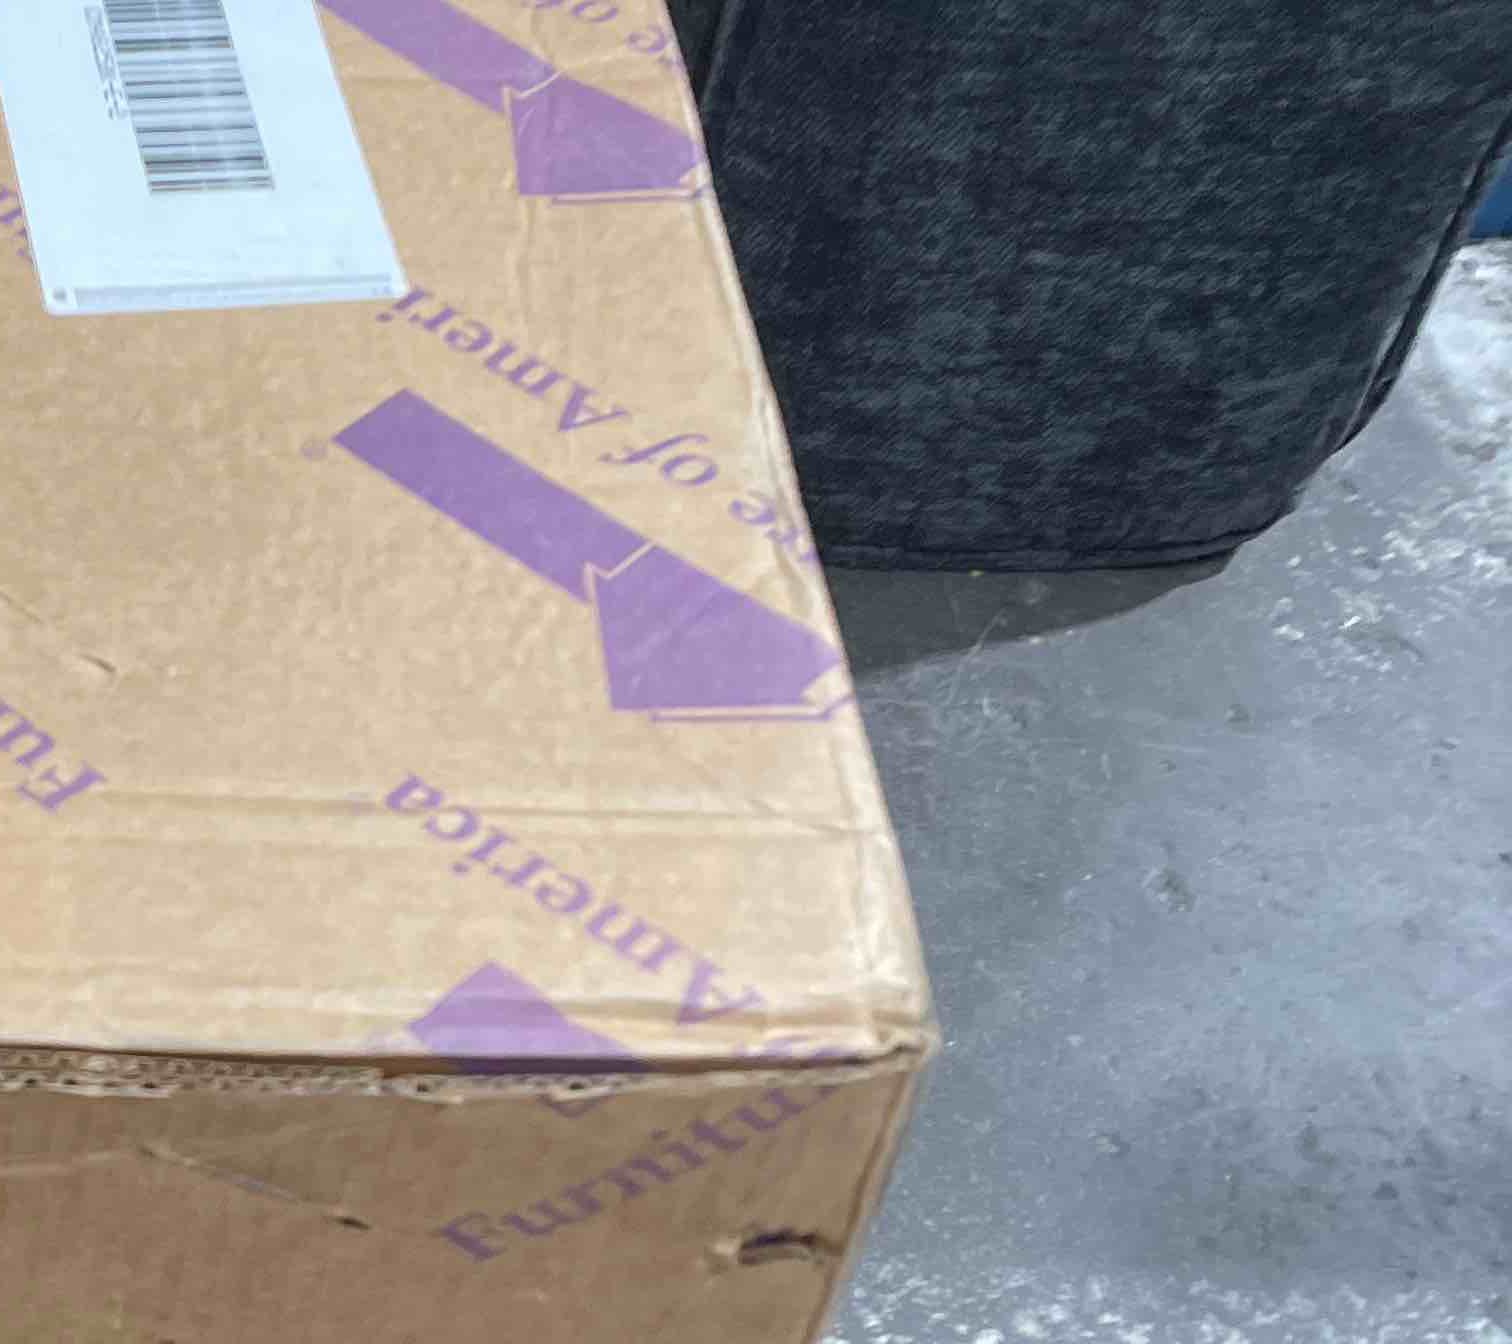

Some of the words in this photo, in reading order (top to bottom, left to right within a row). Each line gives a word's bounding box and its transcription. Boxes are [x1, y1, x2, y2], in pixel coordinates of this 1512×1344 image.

[376, 284, 631, 434] Ameri
[600, 433, 720, 490] of
[385, 774, 765, 1026] America
